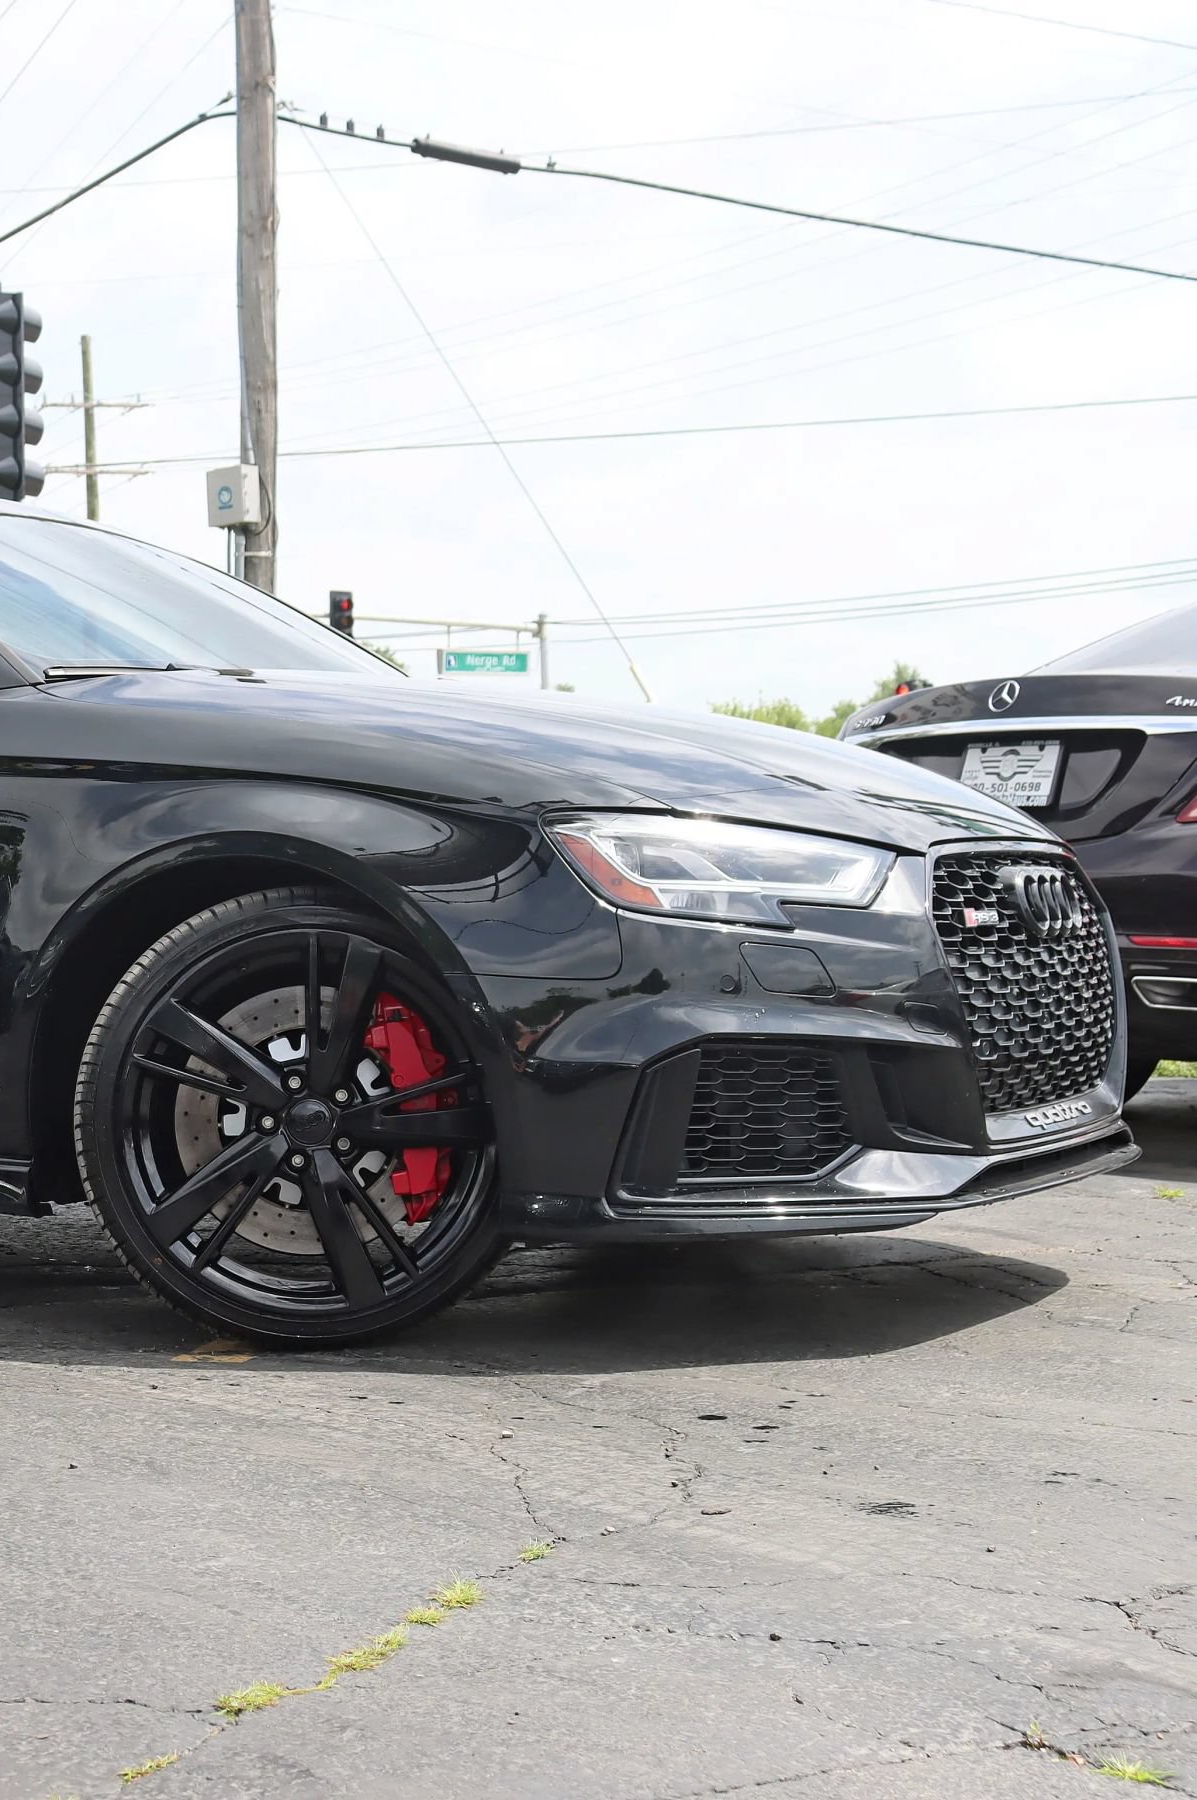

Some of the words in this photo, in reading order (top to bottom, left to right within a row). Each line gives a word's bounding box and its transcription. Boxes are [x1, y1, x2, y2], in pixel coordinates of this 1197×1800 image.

[466, 655, 498, 668] Nerge
[503, 655, 516, 665] Rd
[971, 909, 1000, 923] RS3
[1025, 1101, 1093, 1130] quattro
